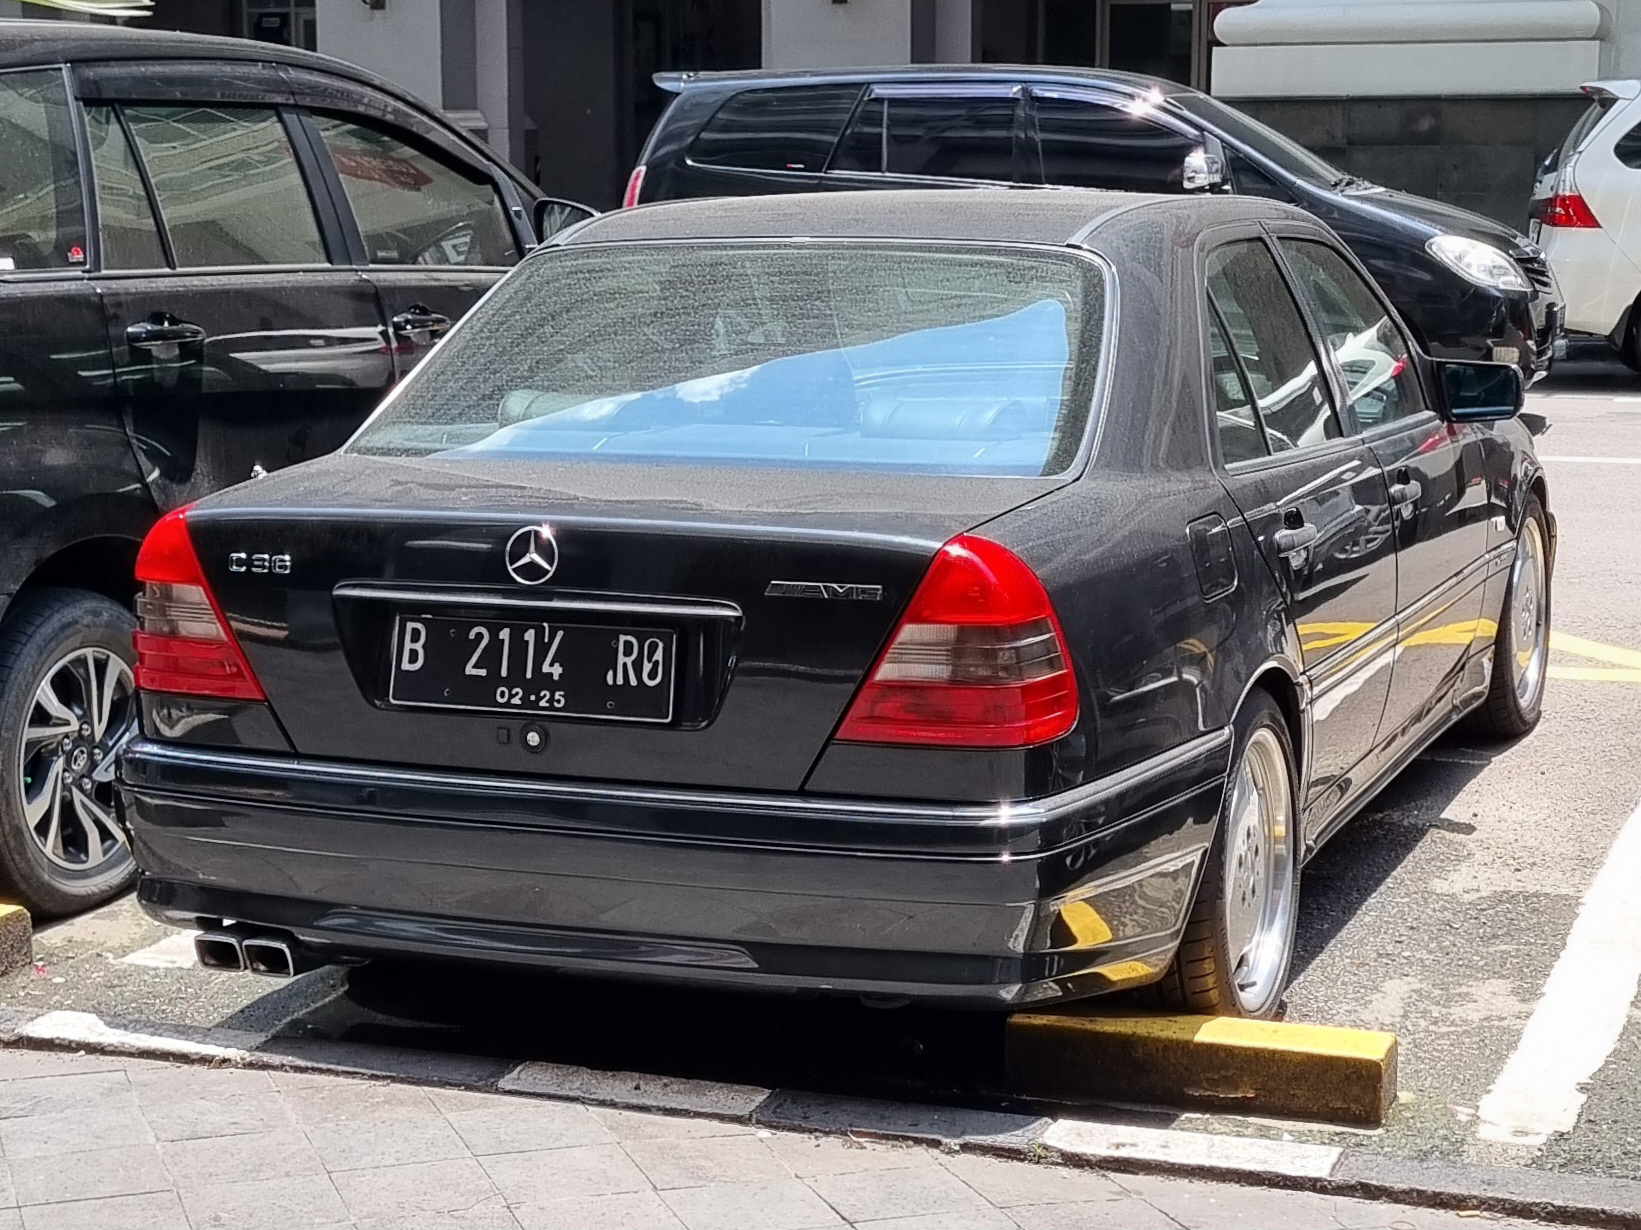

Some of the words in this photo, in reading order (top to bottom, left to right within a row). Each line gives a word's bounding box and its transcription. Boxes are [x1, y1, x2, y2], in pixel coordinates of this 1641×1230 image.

[228, 552, 291, 574] C36
[797, 582, 882, 600] AMG
[401, 621, 426, 671] B
[465, 626, 564, 680] 2114
